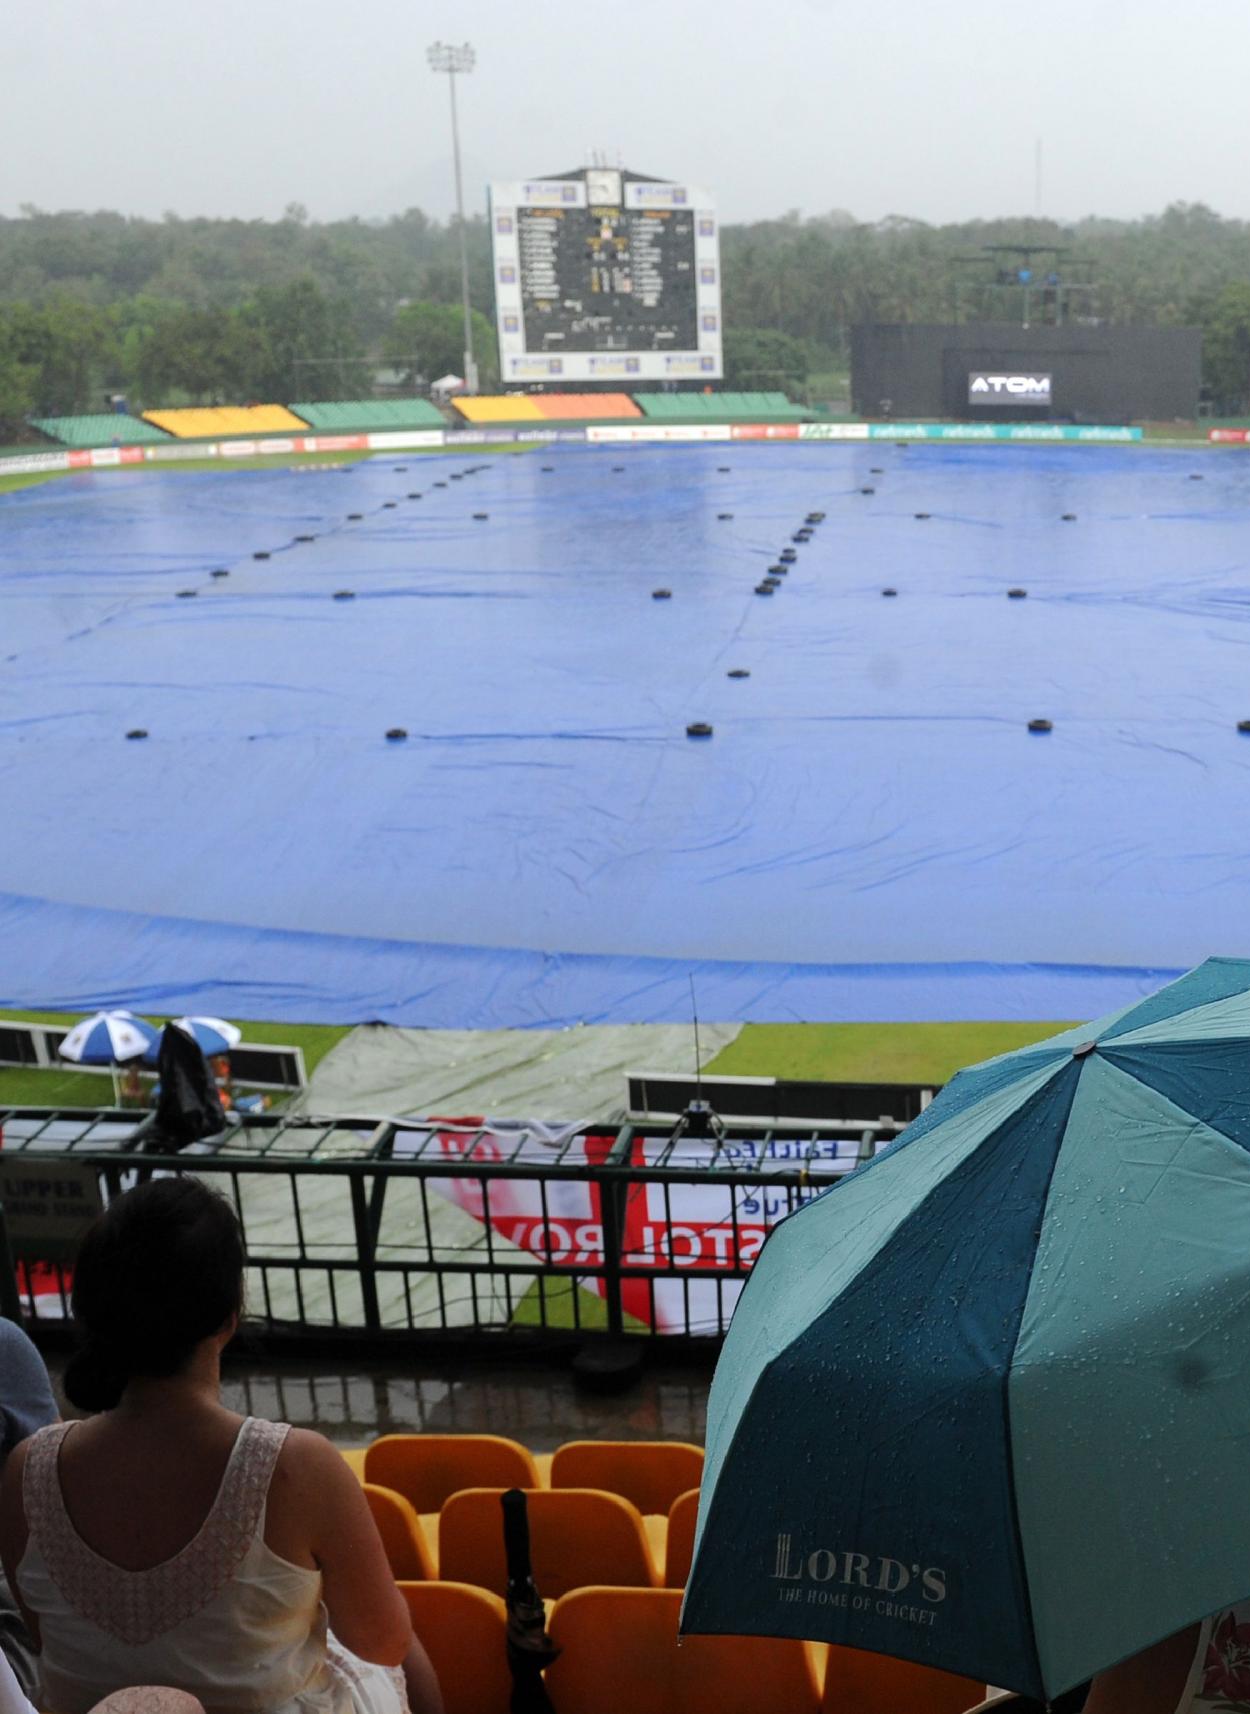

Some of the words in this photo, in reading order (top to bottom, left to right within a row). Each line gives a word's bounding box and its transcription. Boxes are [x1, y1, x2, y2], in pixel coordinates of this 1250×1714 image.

[971, 376, 1050, 393] ATOM
[4, 1178, 84, 1198] UPPER
[777, 1587, 802, 1602] THE
[807, 1589, 848, 1608] HOME
[852, 1595, 872, 1612] OF
[875, 1600, 938, 1627] CRICKET
